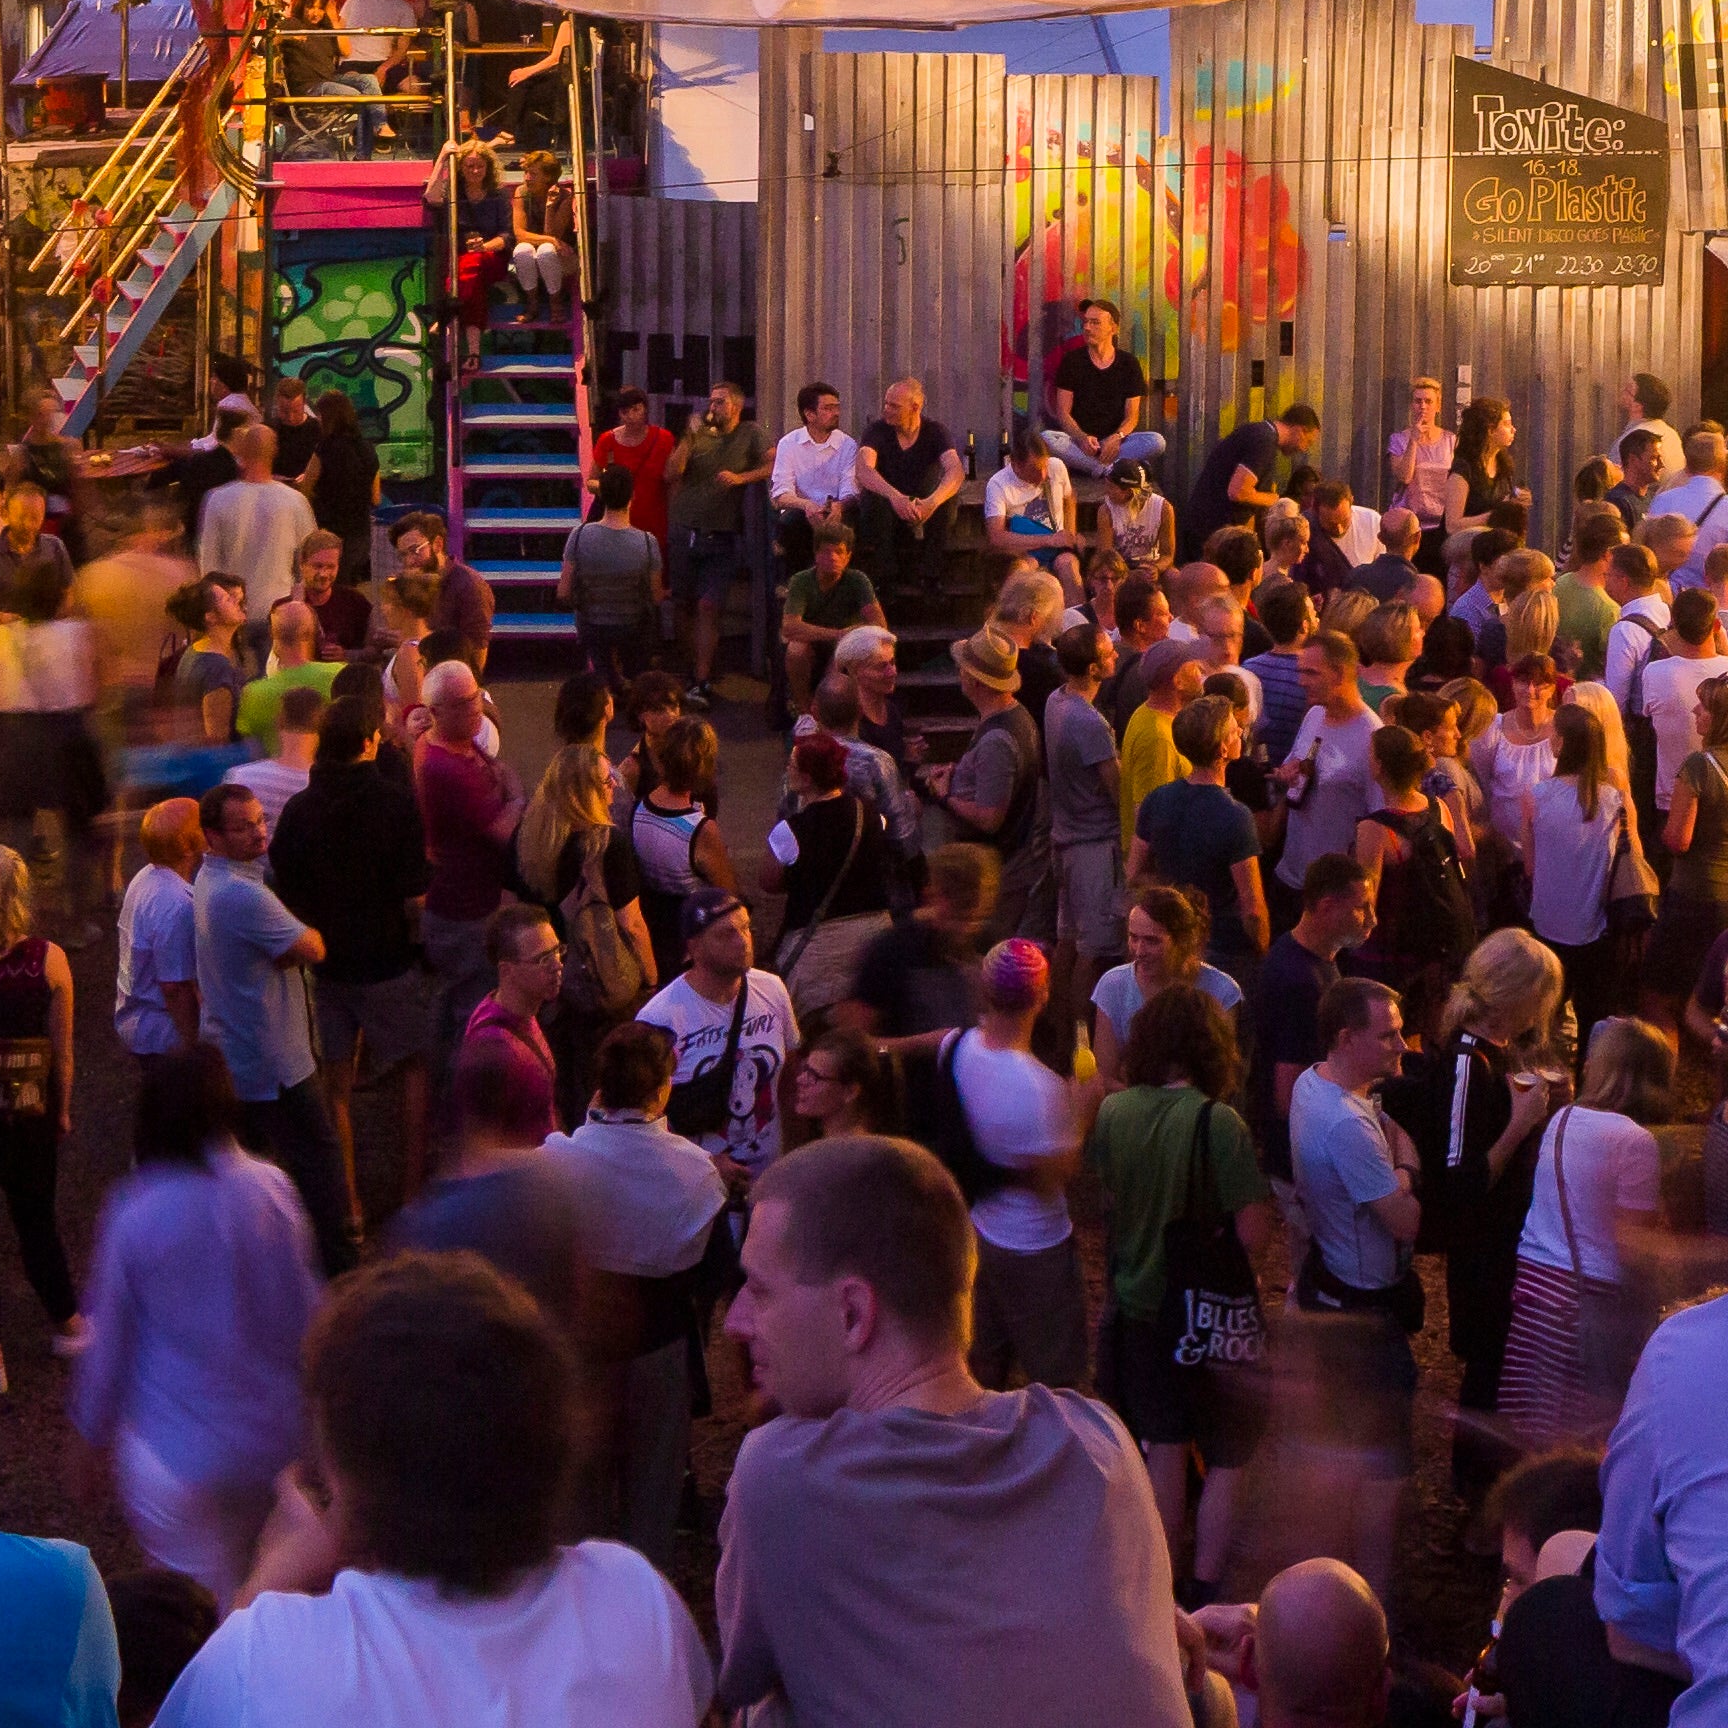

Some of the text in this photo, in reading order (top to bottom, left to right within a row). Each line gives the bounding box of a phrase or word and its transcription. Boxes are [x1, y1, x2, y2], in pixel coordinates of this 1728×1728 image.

[1527, 174, 1647, 224] Plastic
[1482, 227, 1534, 244] SILENT
[1536, 228, 1573, 244] DISCO
[1577, 228, 1609, 244] GOES
